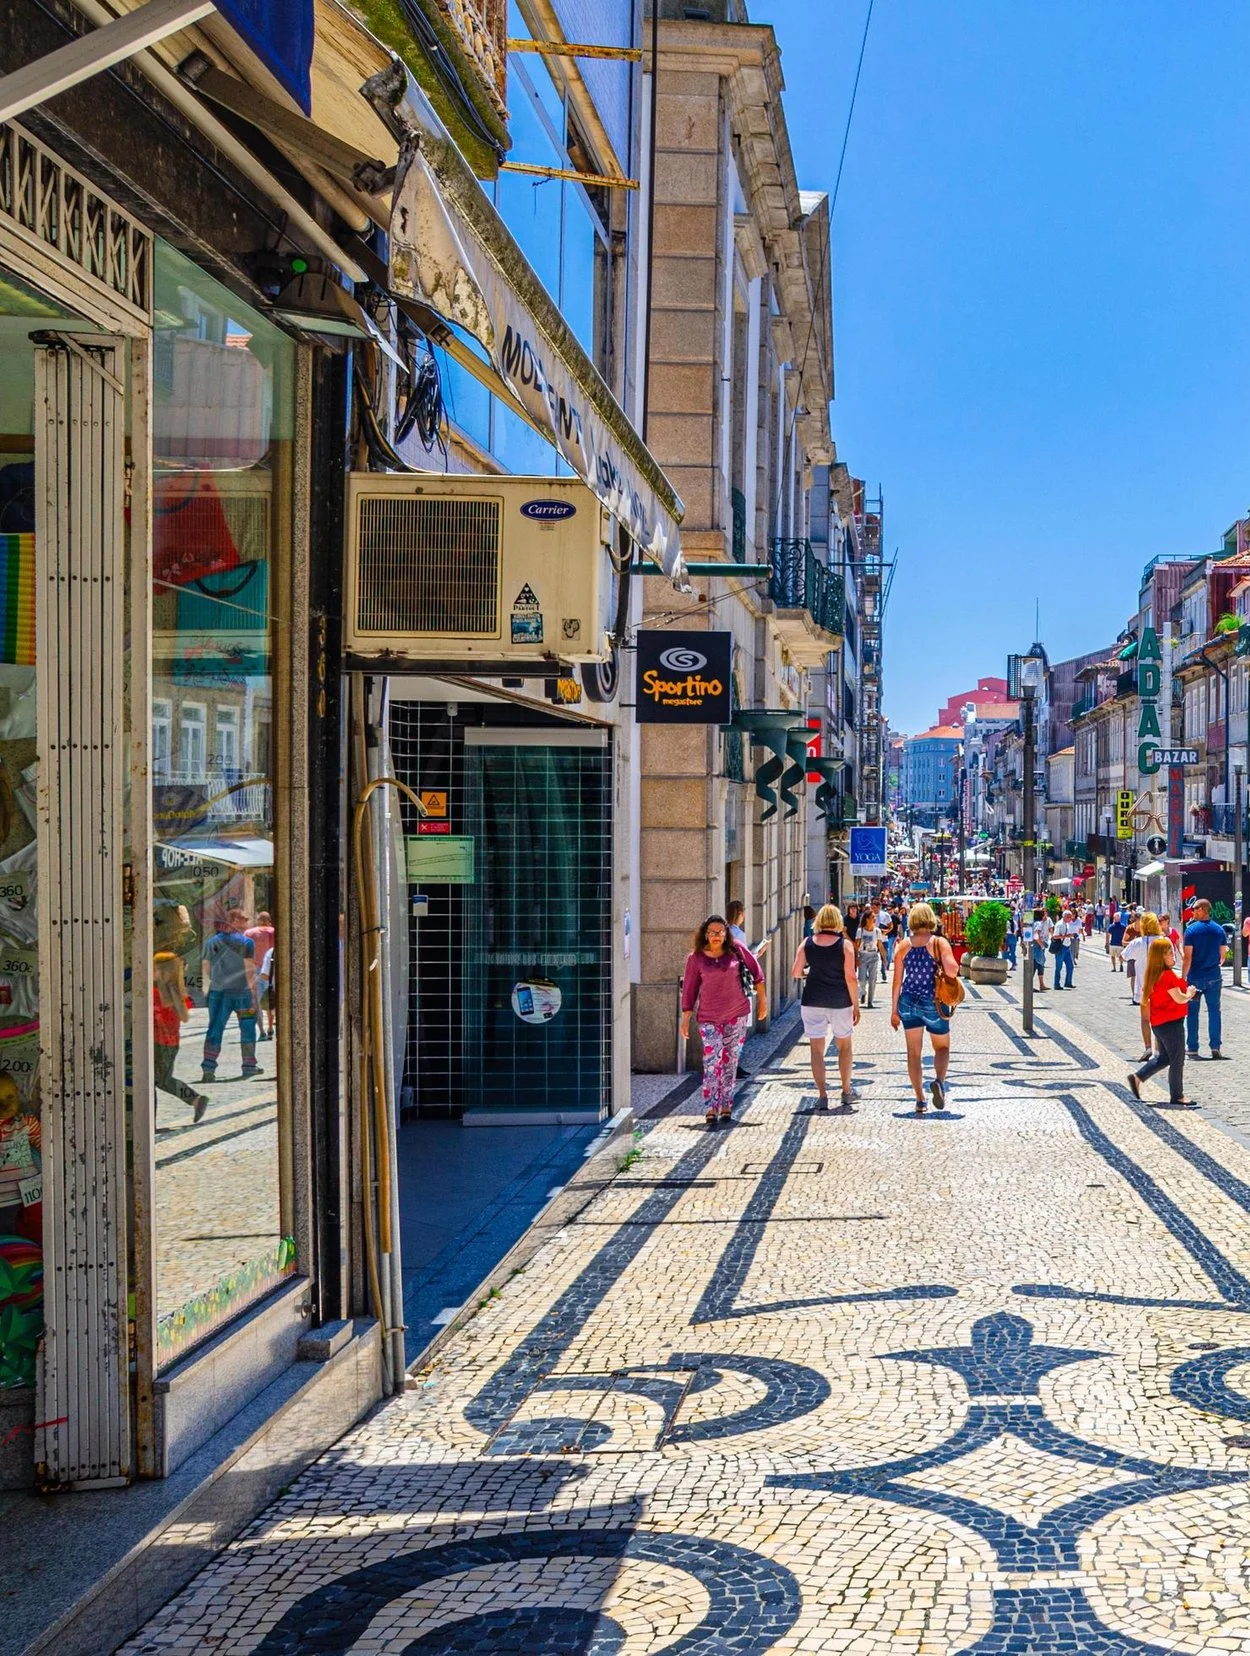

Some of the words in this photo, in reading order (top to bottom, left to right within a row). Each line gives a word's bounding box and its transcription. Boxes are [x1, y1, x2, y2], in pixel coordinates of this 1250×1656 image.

[528, 504, 569, 515] Carrier
[643, 670, 723, 702] Sportino
[662, 698, 703, 707] megastore
[1154, 751, 1198, 763] BAZAR
[854, 852, 881, 862] YOGA
